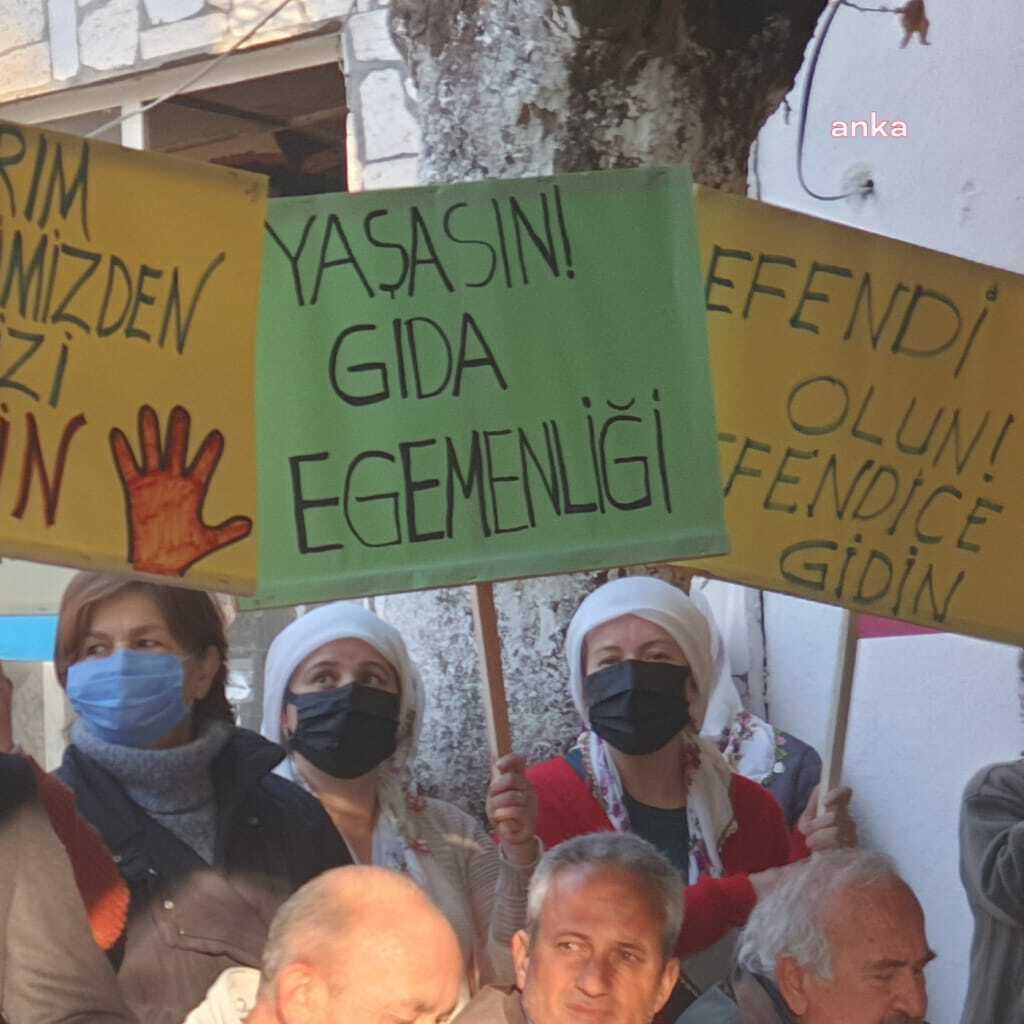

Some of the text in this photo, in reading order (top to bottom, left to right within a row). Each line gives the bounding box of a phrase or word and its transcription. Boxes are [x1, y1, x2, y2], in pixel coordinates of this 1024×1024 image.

[264, 185, 576, 307] YAŞASIN!
[328, 312, 508, 407] GIDA
[705, 244, 998, 379] EFENDİ
[288, 388, 673, 554] EGEMENLİĞİ
[787, 375, 1015, 482] OLUN!
[779, 533, 965, 624] GİDİN
